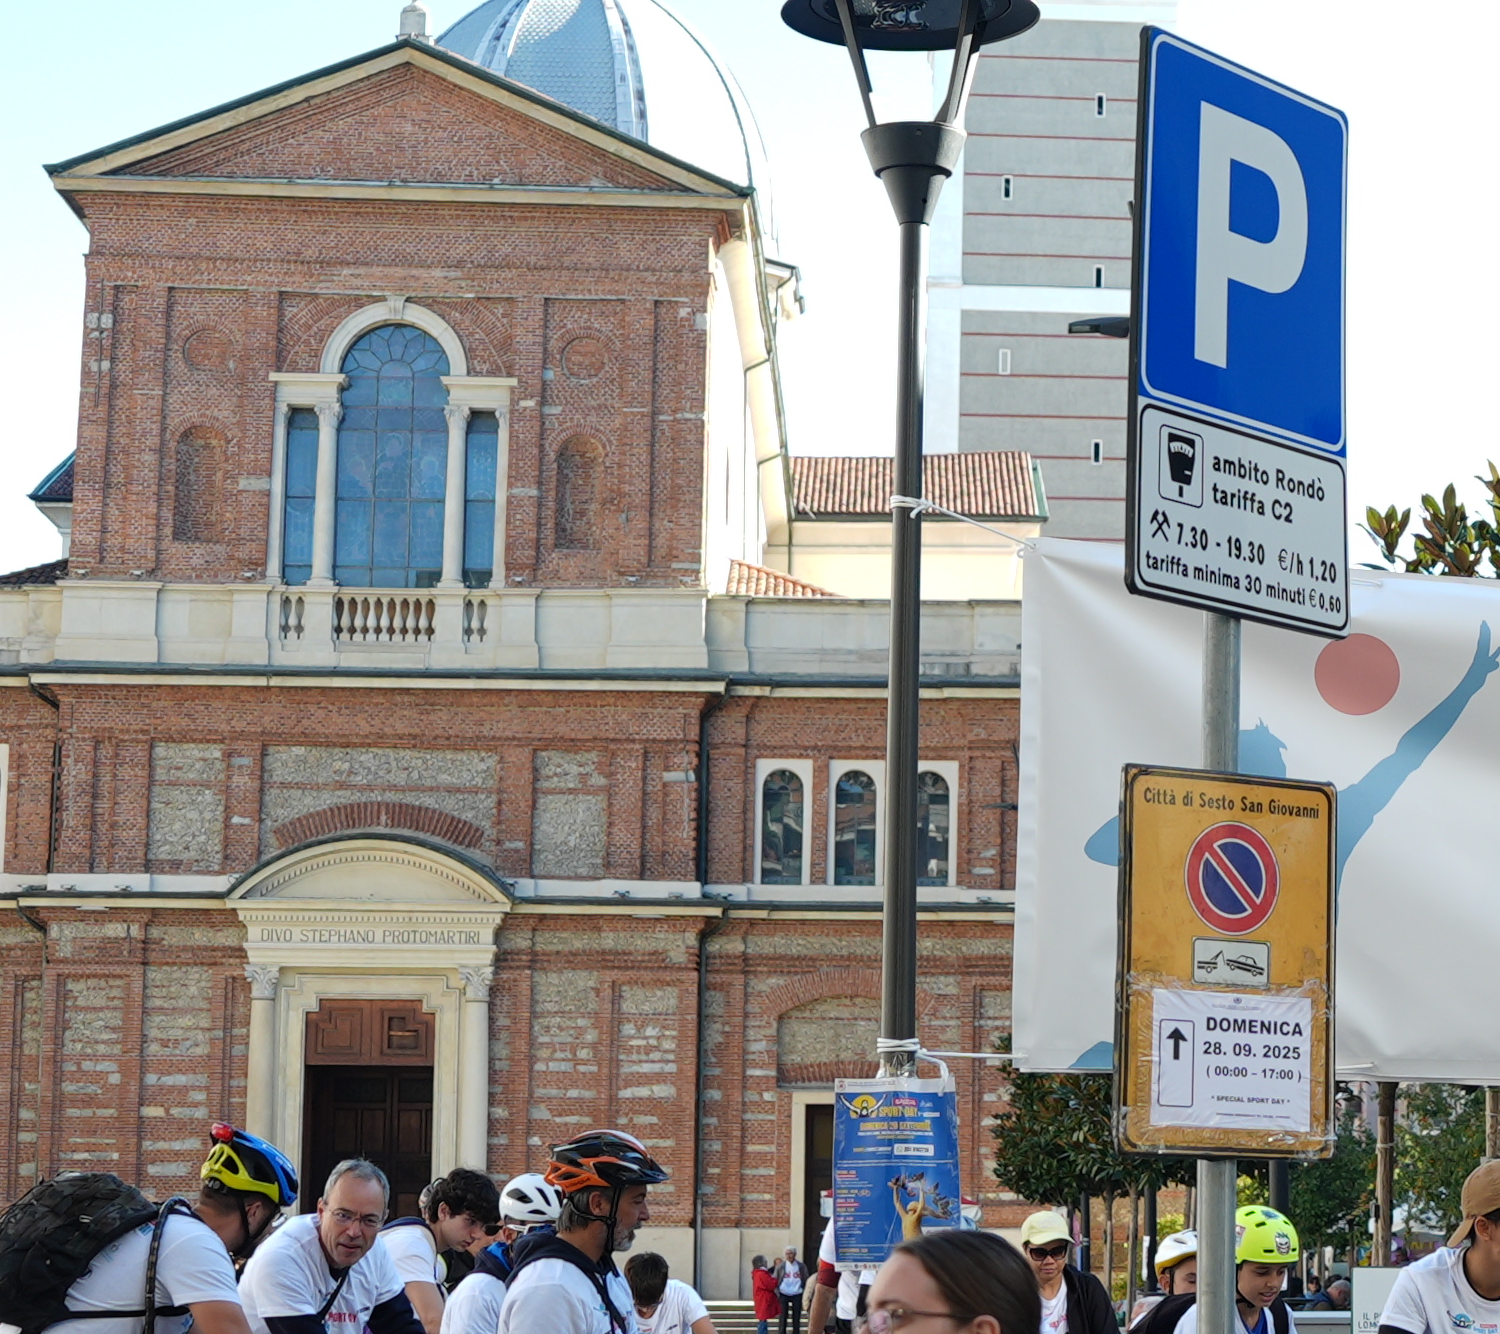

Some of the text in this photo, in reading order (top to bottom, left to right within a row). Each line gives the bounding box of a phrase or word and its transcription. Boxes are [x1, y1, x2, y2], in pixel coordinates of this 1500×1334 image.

[1194, 100, 1308, 368] P
[1212, 455, 1325, 502] ambito Rondò
[1212, 483, 1293, 523] tariffa C2
[1176, 522, 1209, 551] 7.30
[1227, 535, 1265, 565] 19.30
[1277, 548, 1304, 576] €/h
[1145, 551, 1189, 577] tariffa
[1193, 563, 1241, 590] minima
[1245, 575, 1262, 595] 30
[1266, 581, 1306, 606] minuti
[1143, 787, 1320, 819] Città di Sesto San Giovanni
[260, 928, 481, 944] DIVO STEPHANO PROTOMARTIRI
[1206, 1016, 1303, 1037] DOMENICA
[1203, 1041, 1301, 1060] 28. 09. 2025
[1214, 1066, 1248, 1078] 00:00
[1261, 1068, 1294, 1080] 17:00
